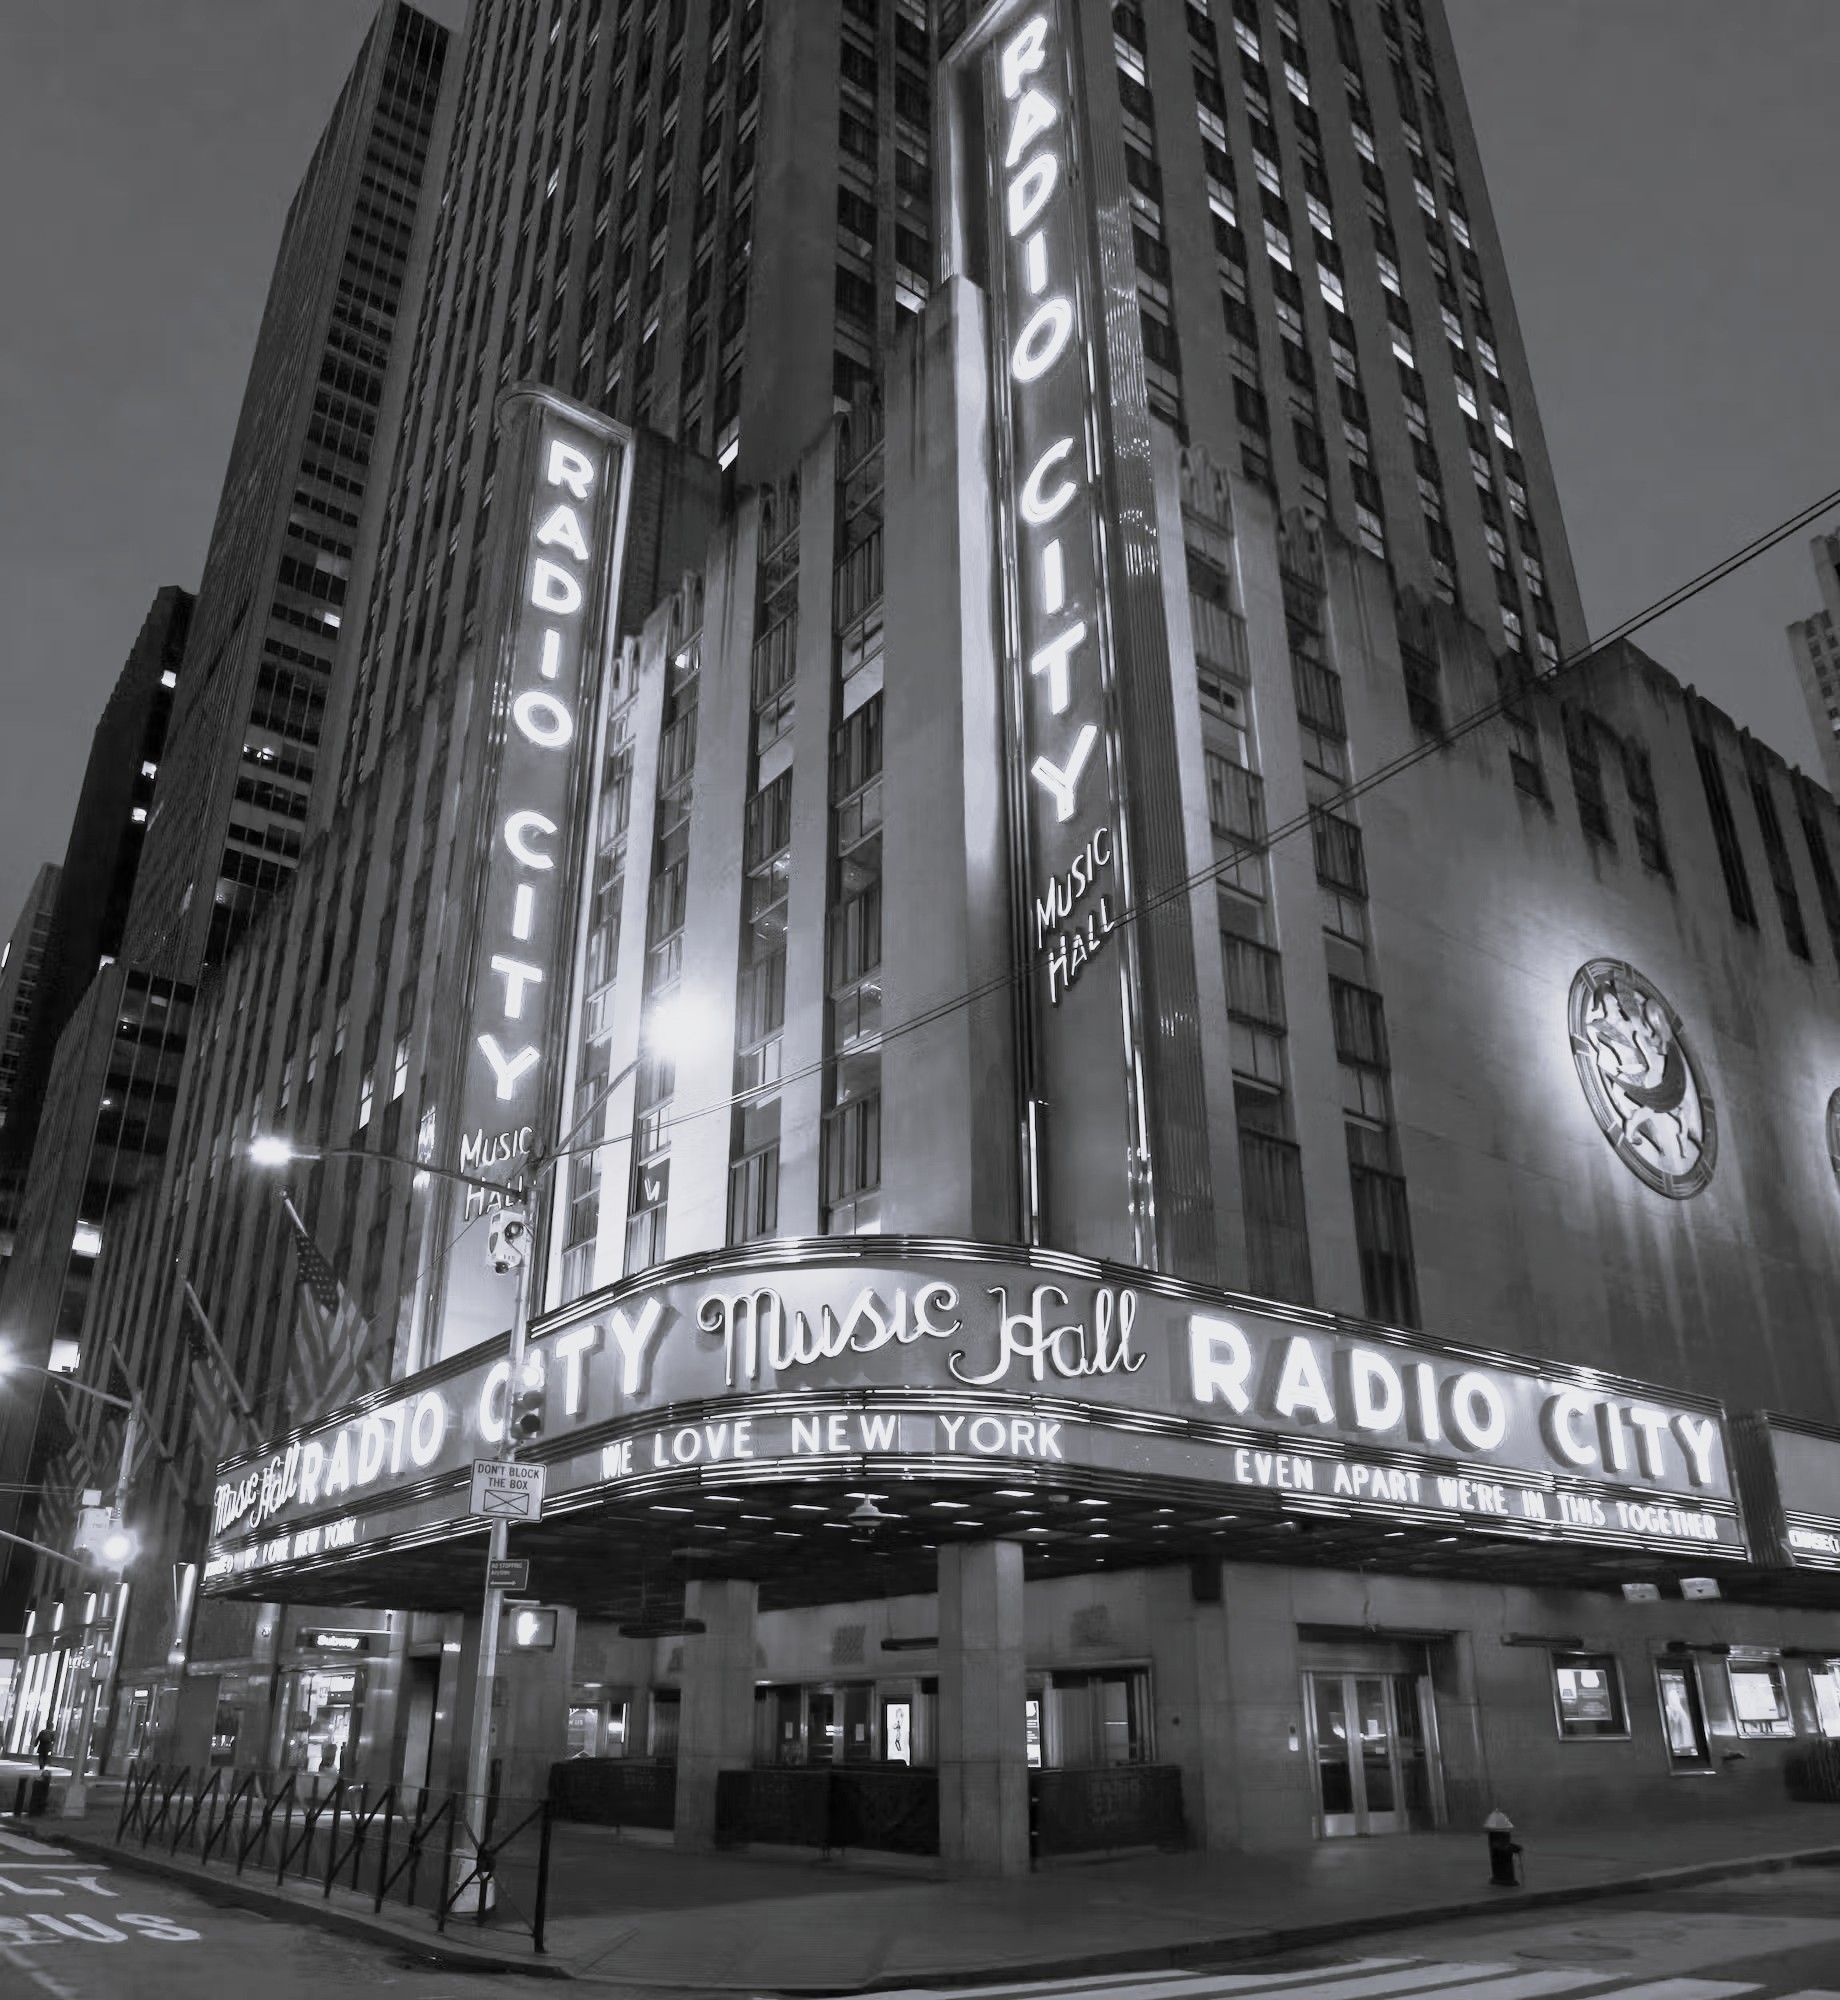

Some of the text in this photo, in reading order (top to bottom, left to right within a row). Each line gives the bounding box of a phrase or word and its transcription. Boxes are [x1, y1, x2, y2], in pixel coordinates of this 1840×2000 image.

[1001, 13, 1098, 826] RADIO CITY
[476, 438, 596, 1102] RADIO CITY
[1036, 827, 1111, 949] MUSIC
[1048, 897, 1115, 1003] HALL
[460, 1126, 533, 1173] MUSIC
[696, 1281, 1147, 1386] Music Hall
[298, 1391, 444, 1504] RADIO
[602, 1414, 1063, 1479] WE LOVE NEW YORK
[1188, 1313, 1715, 1485] RADIO CITY
[477, 1463, 541, 1479] DON'T BLOCK
[487, 1477, 529, 1490] THE BOX
[1234, 1448, 1720, 1541] EVEN APART WE'RE IN THIS TOGETHER
